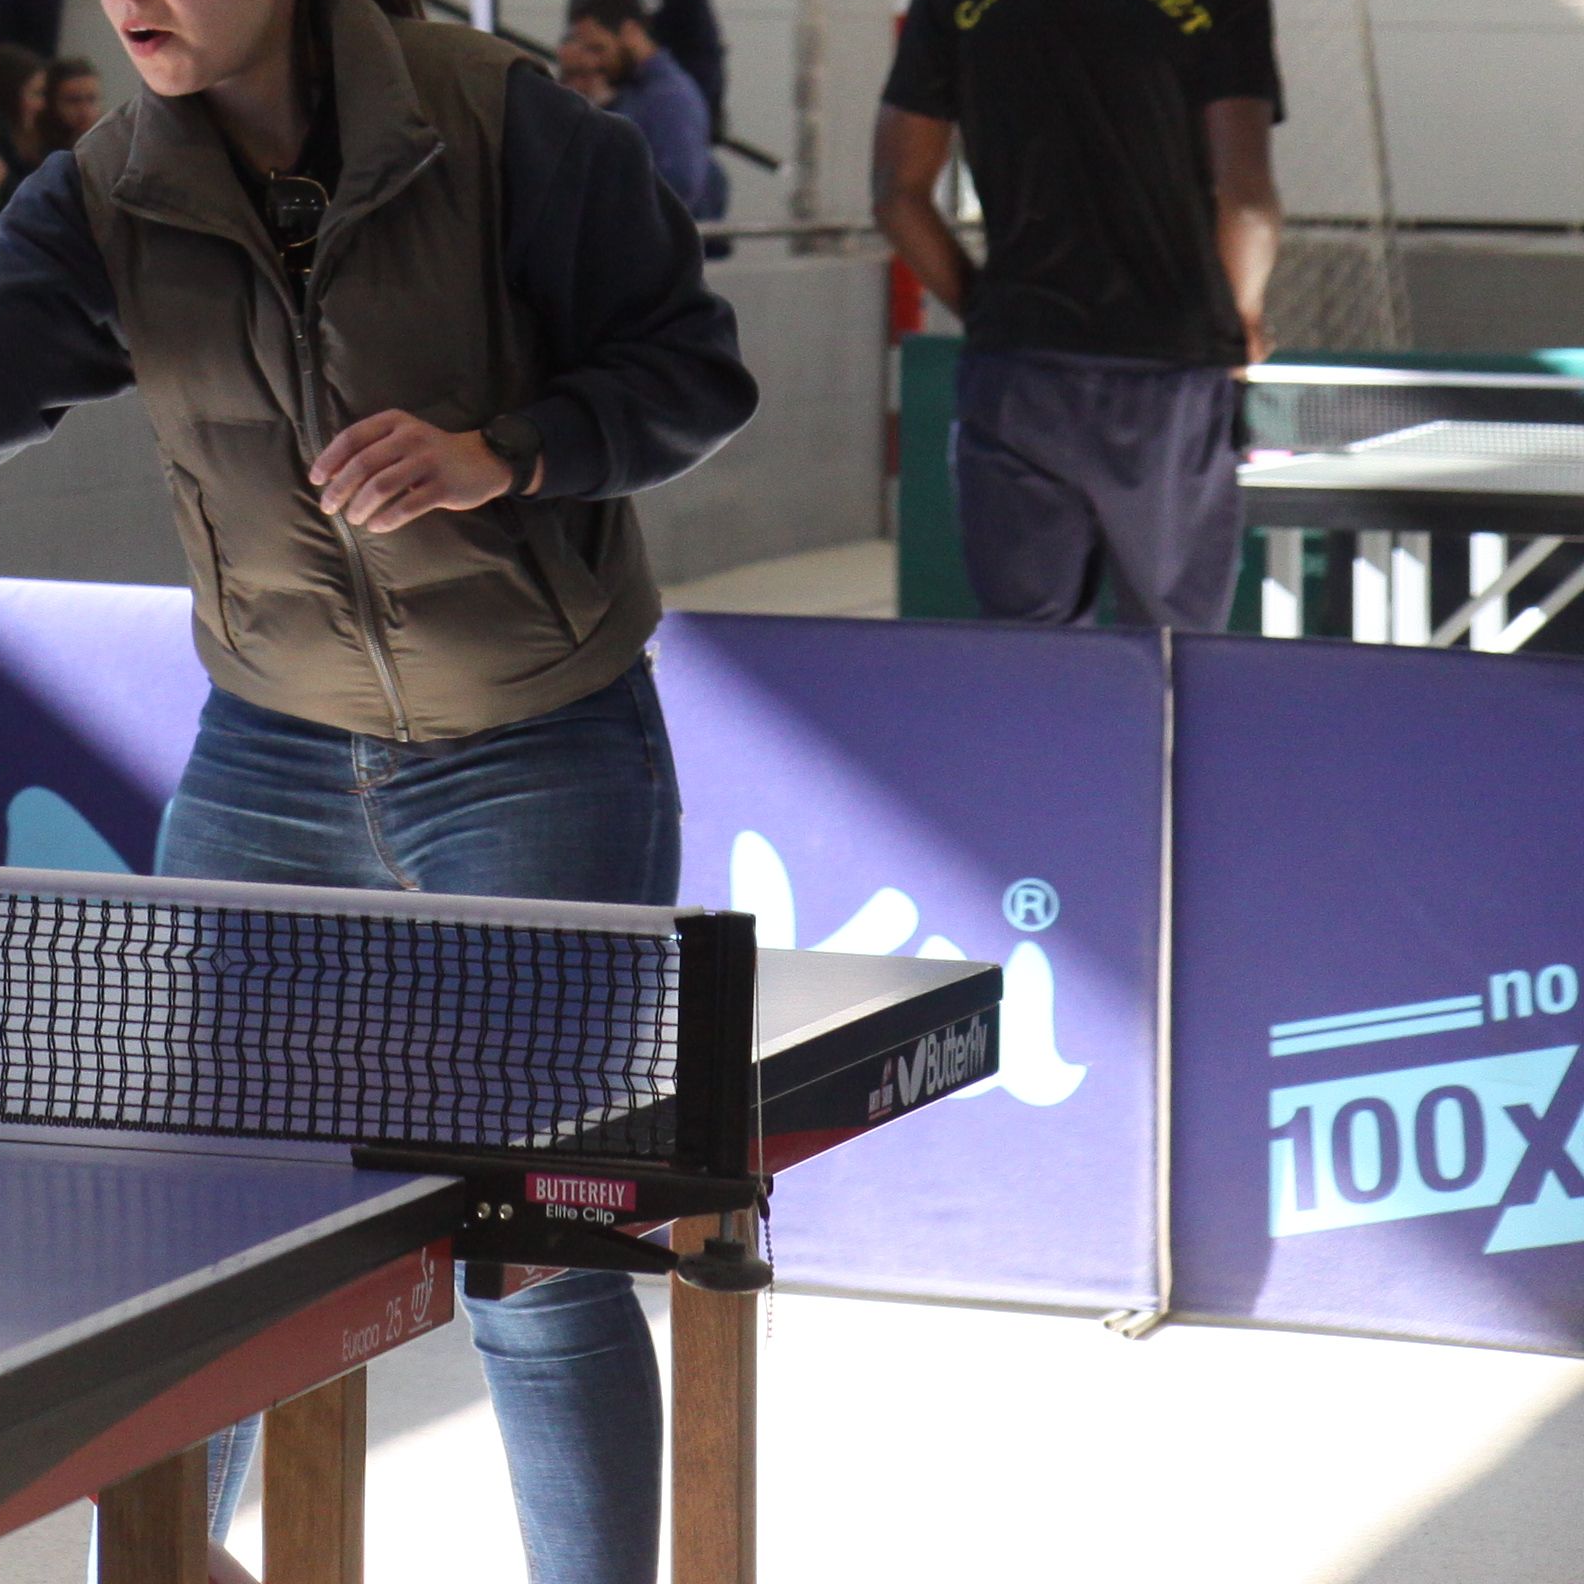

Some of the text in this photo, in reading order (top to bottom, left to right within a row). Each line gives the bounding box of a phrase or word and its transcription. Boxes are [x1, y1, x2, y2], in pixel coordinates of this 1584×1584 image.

[926, 1015, 988, 1096] Butterfly
[535, 1177, 625, 1207] BUTTERFLY
[545, 1203, 615, 1226] Elite Clip
[342, 1297, 402, 1362] Europa 25
